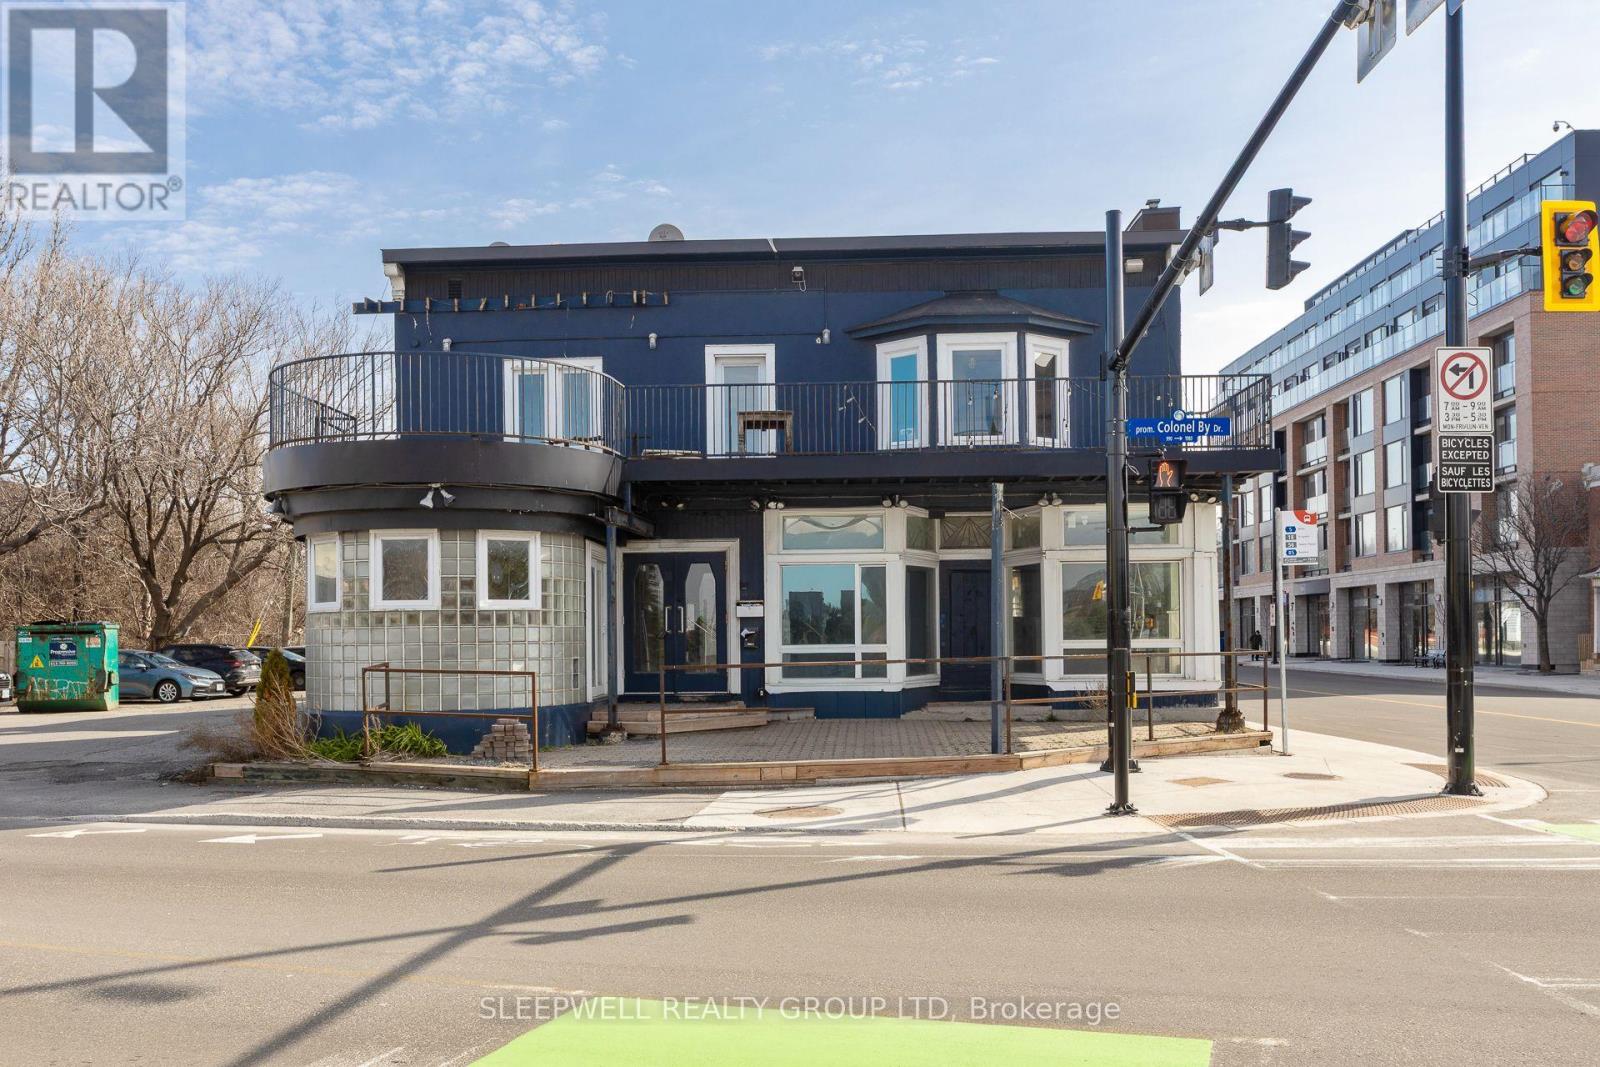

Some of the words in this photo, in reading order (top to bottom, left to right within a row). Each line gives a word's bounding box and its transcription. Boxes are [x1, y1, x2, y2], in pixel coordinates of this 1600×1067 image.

[1443, 401, 1449, 411] 7
[1470, 401, 1476, 411] 9
[1444, 412, 1450, 422] 3
[1470, 412, 1476, 422] 5
[1135, 427, 1155, 435] prom.
[1157, 420, 1195, 433] Colonel
[1198, 421, 1211, 436] By
[1213, 424, 1224, 433] Dr.
[1441, 439, 1490, 448] BICYCLES
[1441, 450, 1490, 460] EXCEPTED
[1441, 467, 1467, 476] SAUF
[1472, 467, 1491, 476] LES
[1441, 477, 1491, 488] BICYCLETTES
